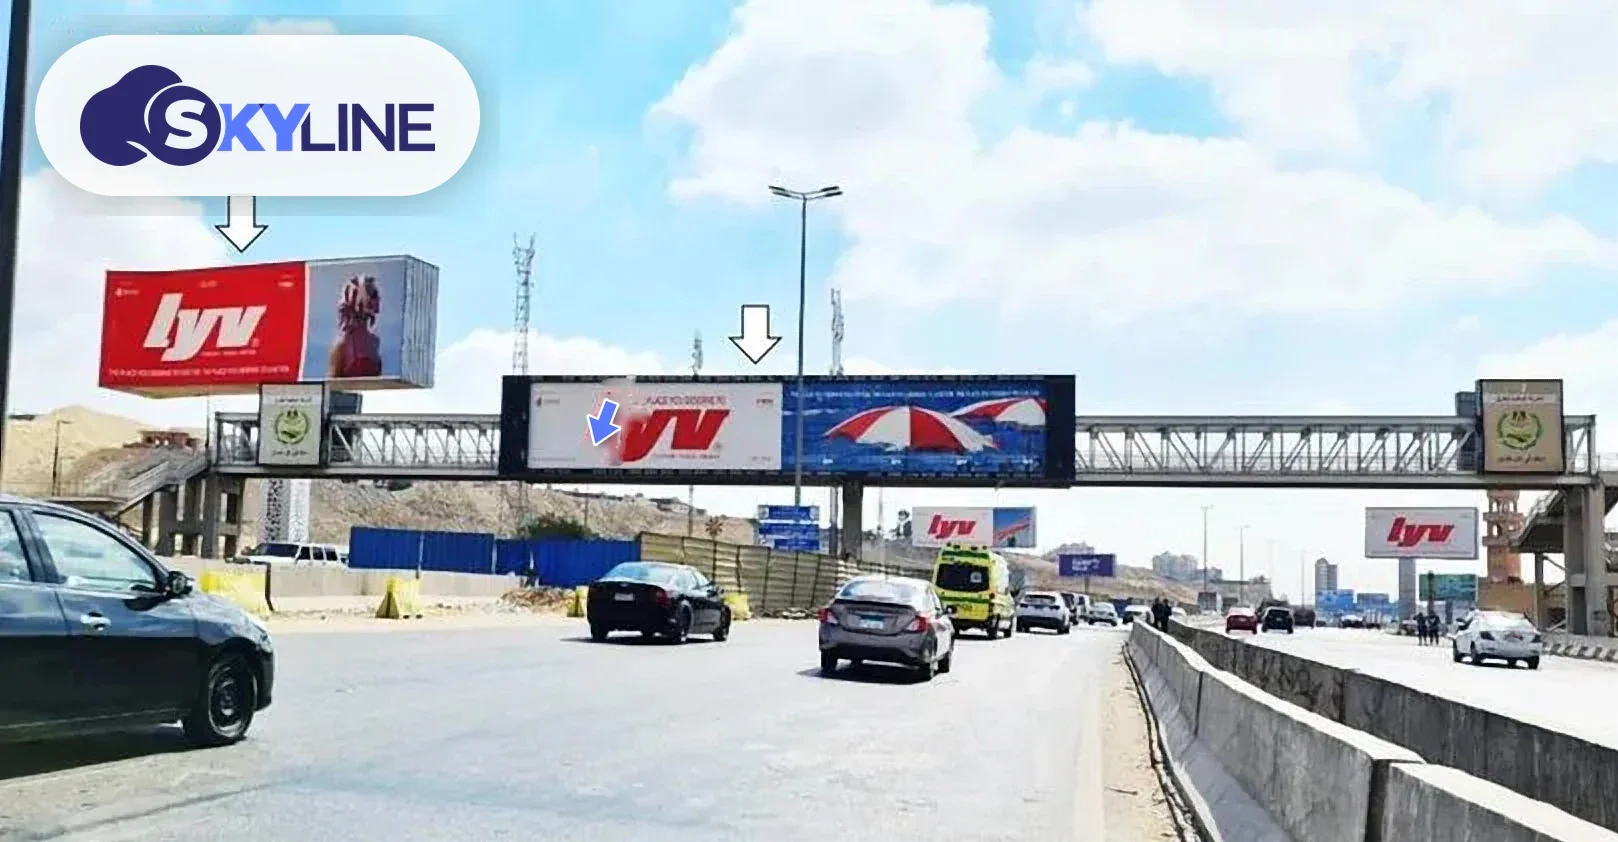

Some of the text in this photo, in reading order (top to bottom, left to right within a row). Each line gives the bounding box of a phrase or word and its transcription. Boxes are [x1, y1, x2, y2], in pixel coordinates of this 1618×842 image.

[143, 293, 266, 362] lyv
[928, 513, 976, 540] lyv
[1387, 516, 1454, 547] lyv
